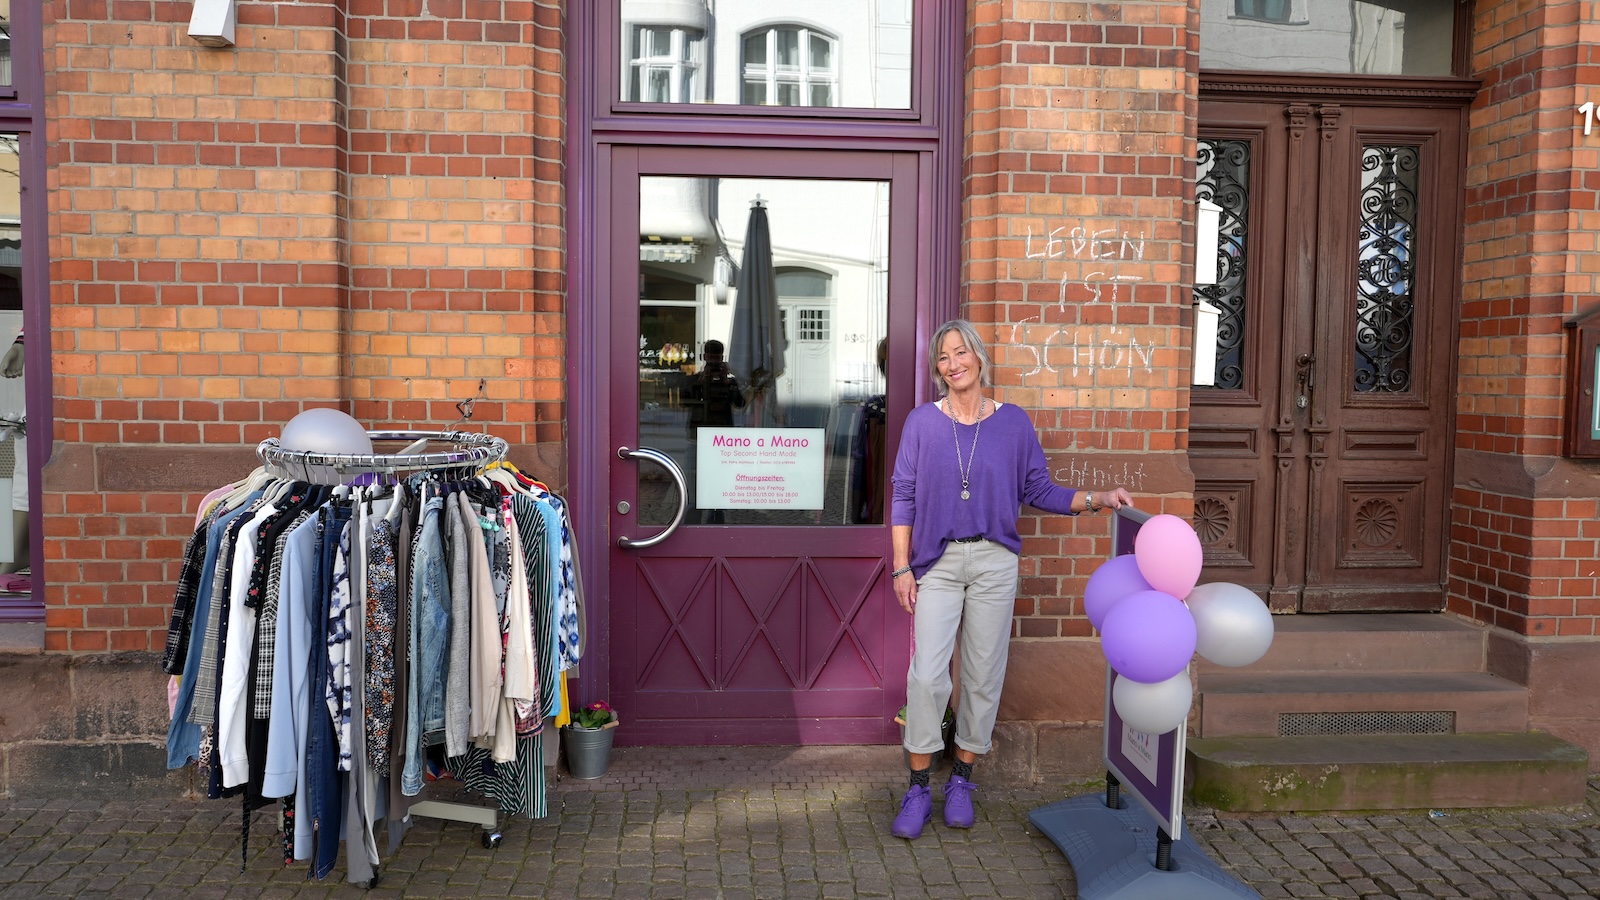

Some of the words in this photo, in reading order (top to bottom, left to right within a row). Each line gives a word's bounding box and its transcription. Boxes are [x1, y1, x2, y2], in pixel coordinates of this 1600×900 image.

[1578, 101, 1600, 136] 1
[1025, 225, 1145, 261] LEBEN
[1059, 271, 1143, 313] IST
[1010, 315, 1155, 378] SCHÖN
[712, 434, 751, 447] Mano
[757, 438, 765, 447] a
[771, 435, 809, 448] Mano
[720, 450, 732, 458] Top
